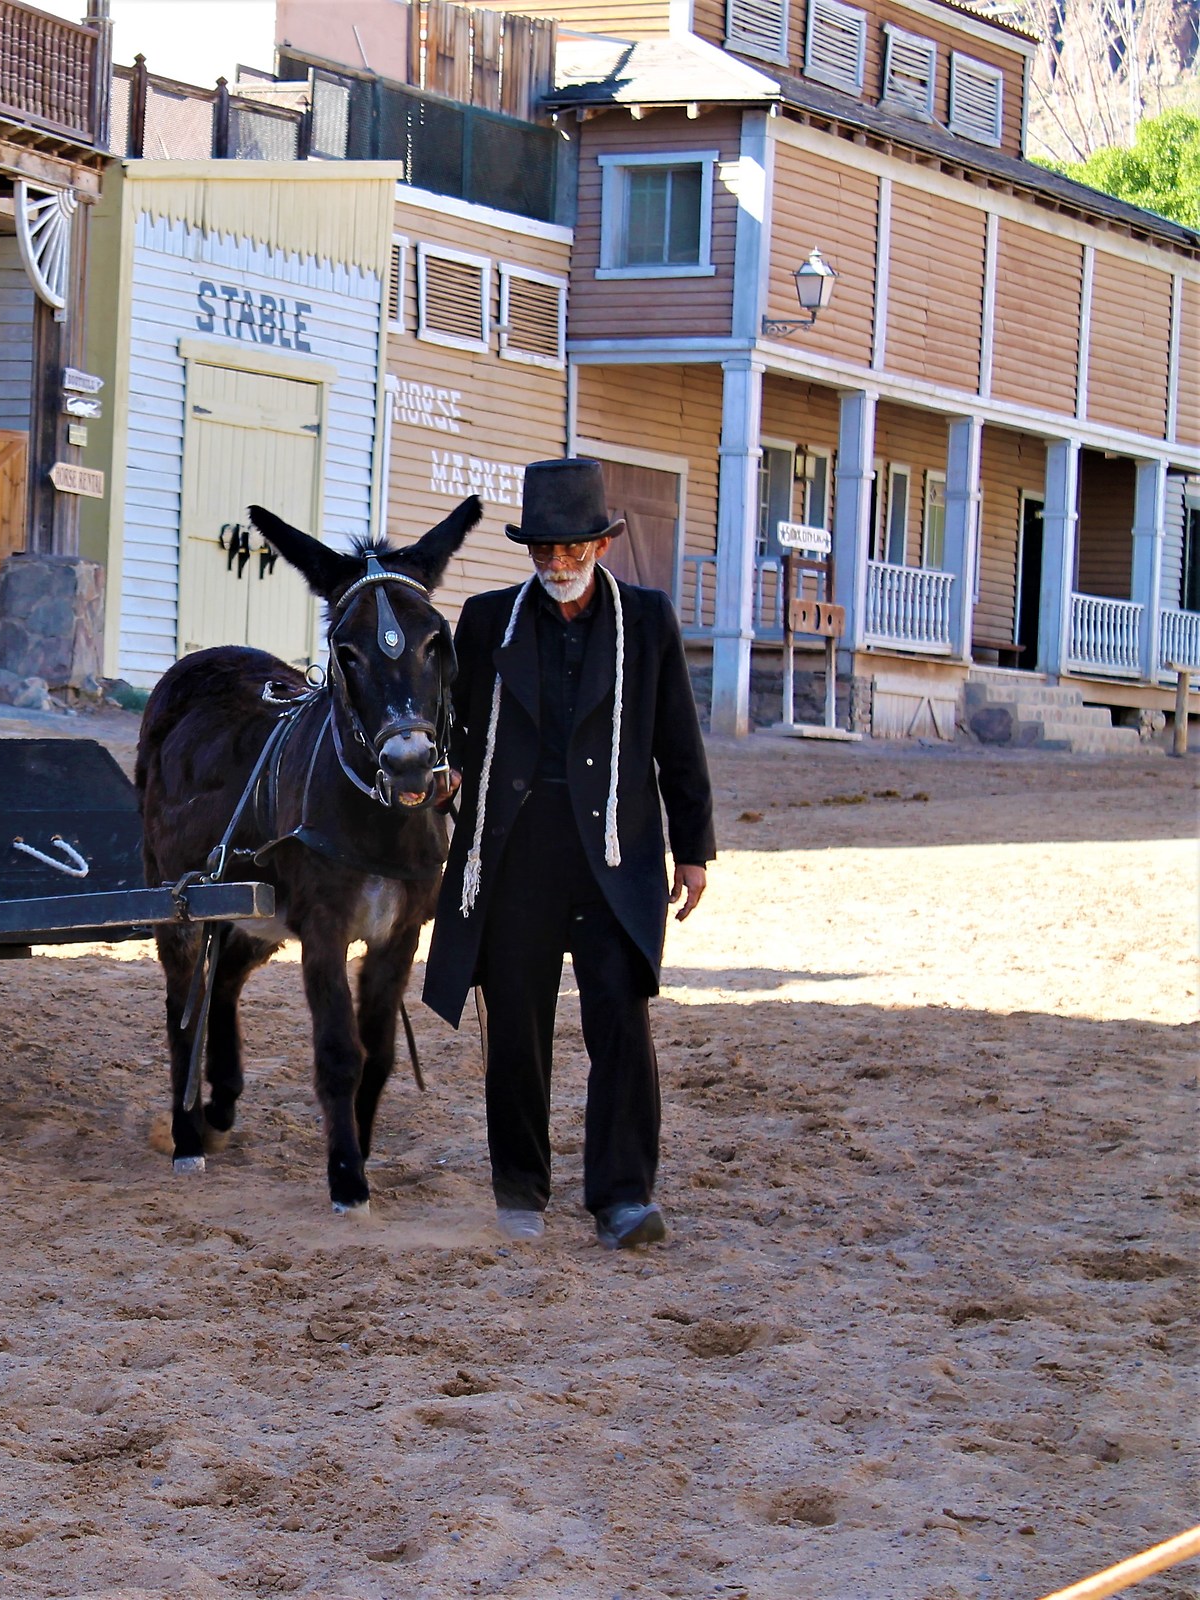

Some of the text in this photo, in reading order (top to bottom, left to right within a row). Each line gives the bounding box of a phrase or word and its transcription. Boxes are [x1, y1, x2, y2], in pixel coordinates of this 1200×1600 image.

[196, 280, 312, 353] STABLE
[394, 380, 462, 433] HORSE
[56, 466, 103, 494] HORSE RENTAL
[430, 450, 525, 507] MARKET
